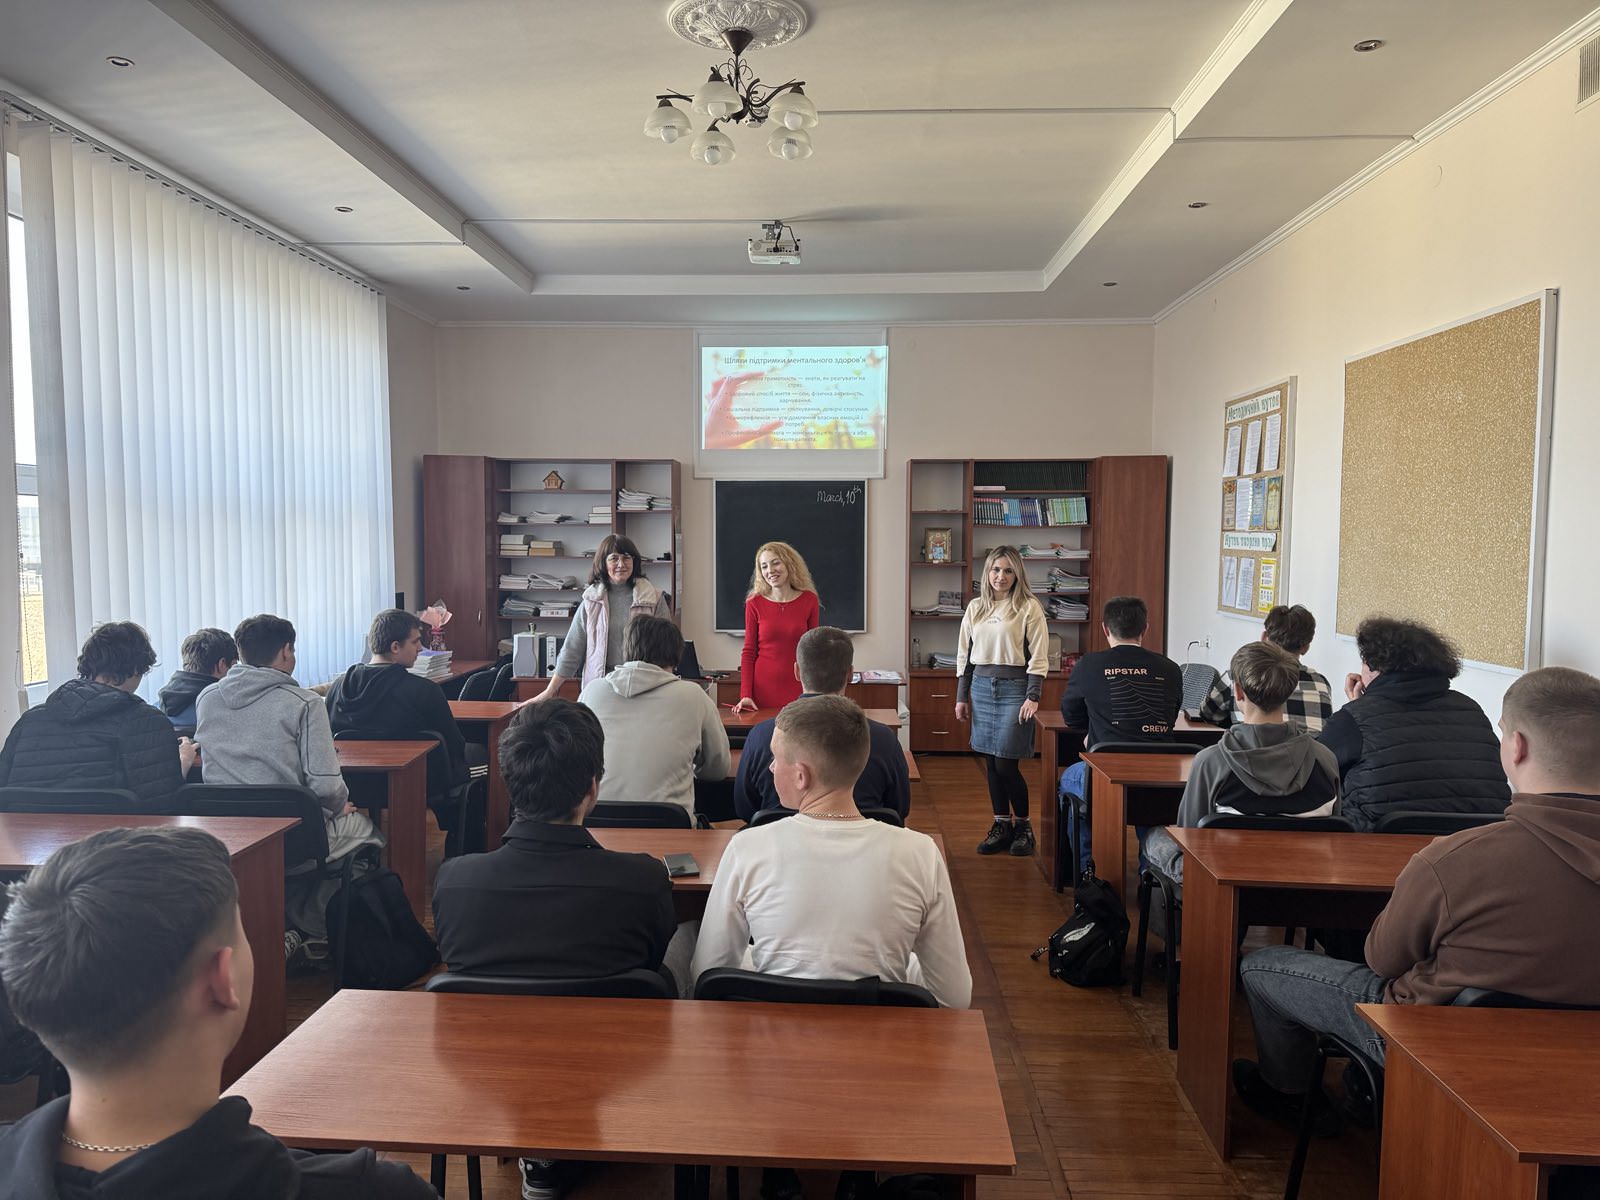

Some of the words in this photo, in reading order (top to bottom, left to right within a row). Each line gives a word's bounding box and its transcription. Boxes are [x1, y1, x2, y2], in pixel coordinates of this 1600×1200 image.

[724, 356, 748, 365] Шляхи
[749, 356, 786, 366] підтримки
[787, 356, 834, 365] ментального
[1104, 667, 1148, 676] RIPSTAR
[1141, 724, 1169, 733] CREW
